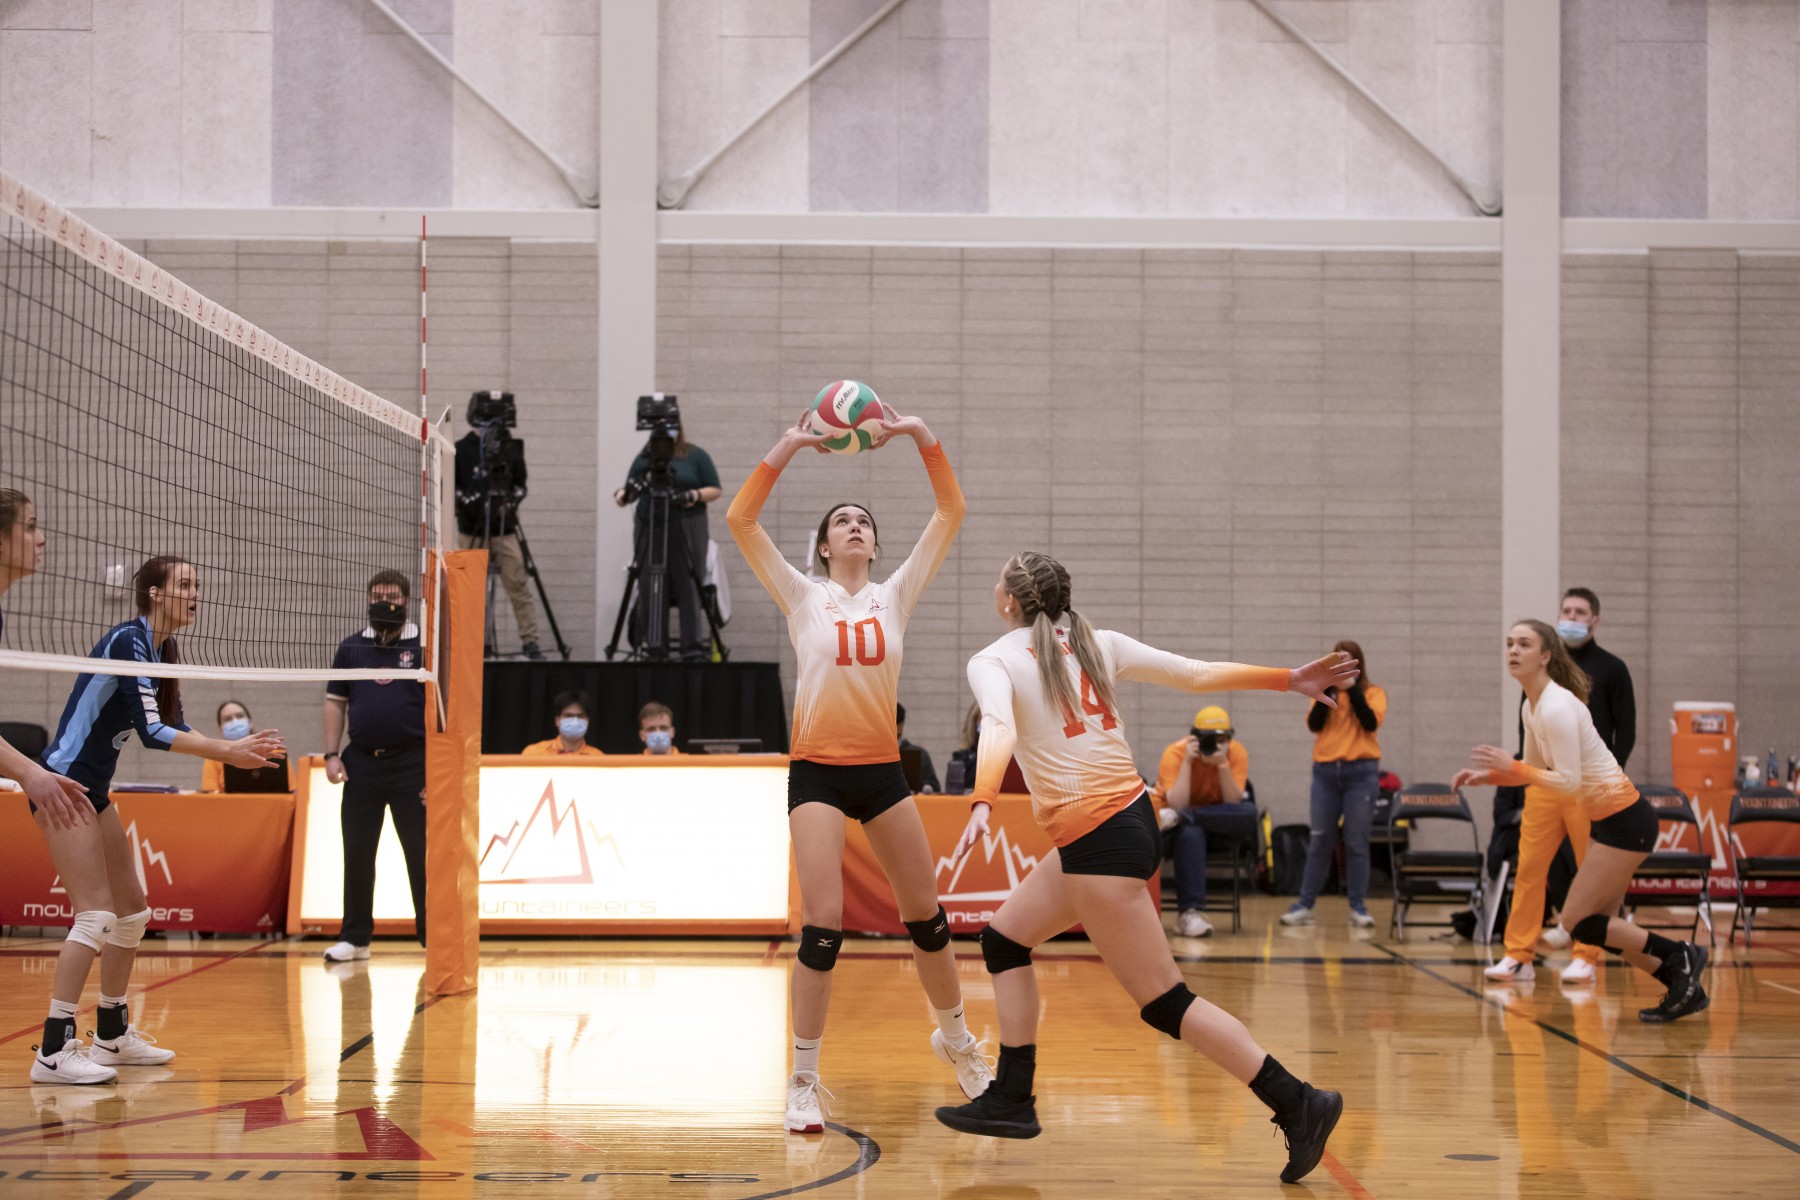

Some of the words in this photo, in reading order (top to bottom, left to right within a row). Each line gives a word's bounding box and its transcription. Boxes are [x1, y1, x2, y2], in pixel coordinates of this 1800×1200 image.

[835, 617, 885, 666] 10
[1062, 668, 1117, 738] 14
[482, 900, 657, 915] untaineers
